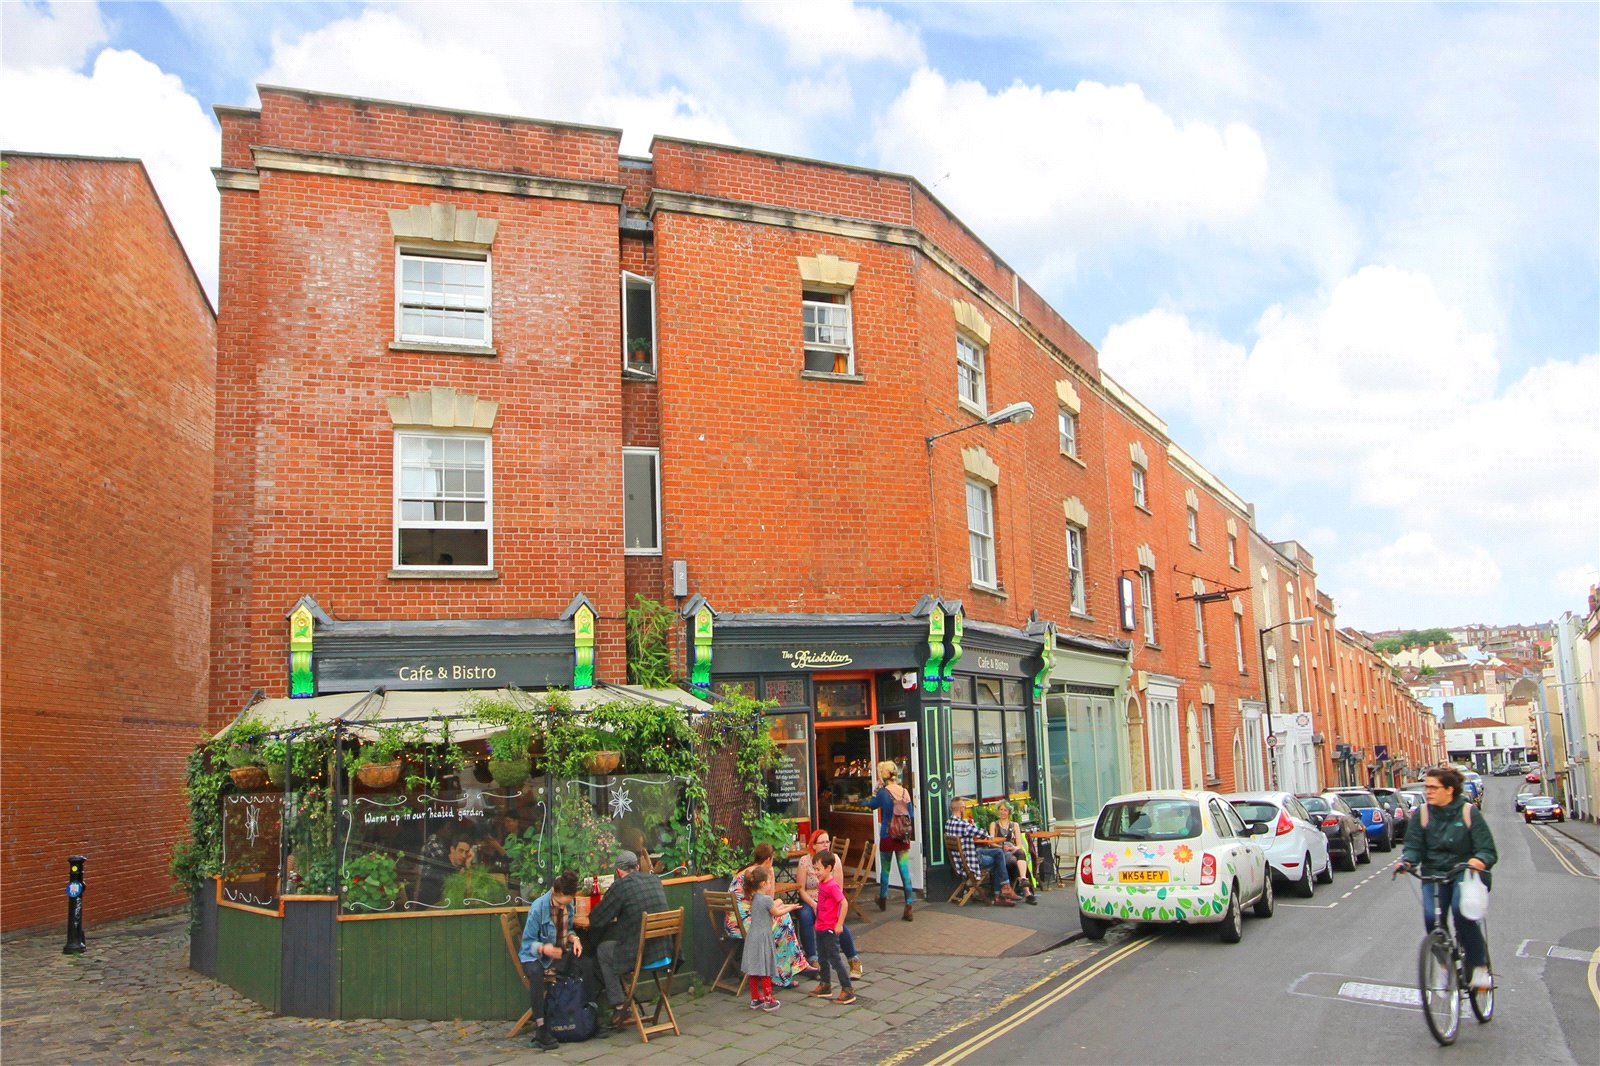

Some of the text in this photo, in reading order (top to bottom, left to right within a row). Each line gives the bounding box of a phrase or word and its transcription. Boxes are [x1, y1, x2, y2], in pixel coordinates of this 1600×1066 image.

[782, 650, 853, 669] The Bristolian
[978, 656, 990, 669] Cafe
[994, 658, 1010, 671] Bistro
[399, 665, 496, 681] Cafe & Bistro
[364, 812, 388, 824] Warm
[390, 813, 401, 826] up
[412, 812, 426, 820] our
[458, 808, 484, 822] garden
[1122, 871, 1145, 881] WK54
[1147, 871, 1164, 880] EFY
